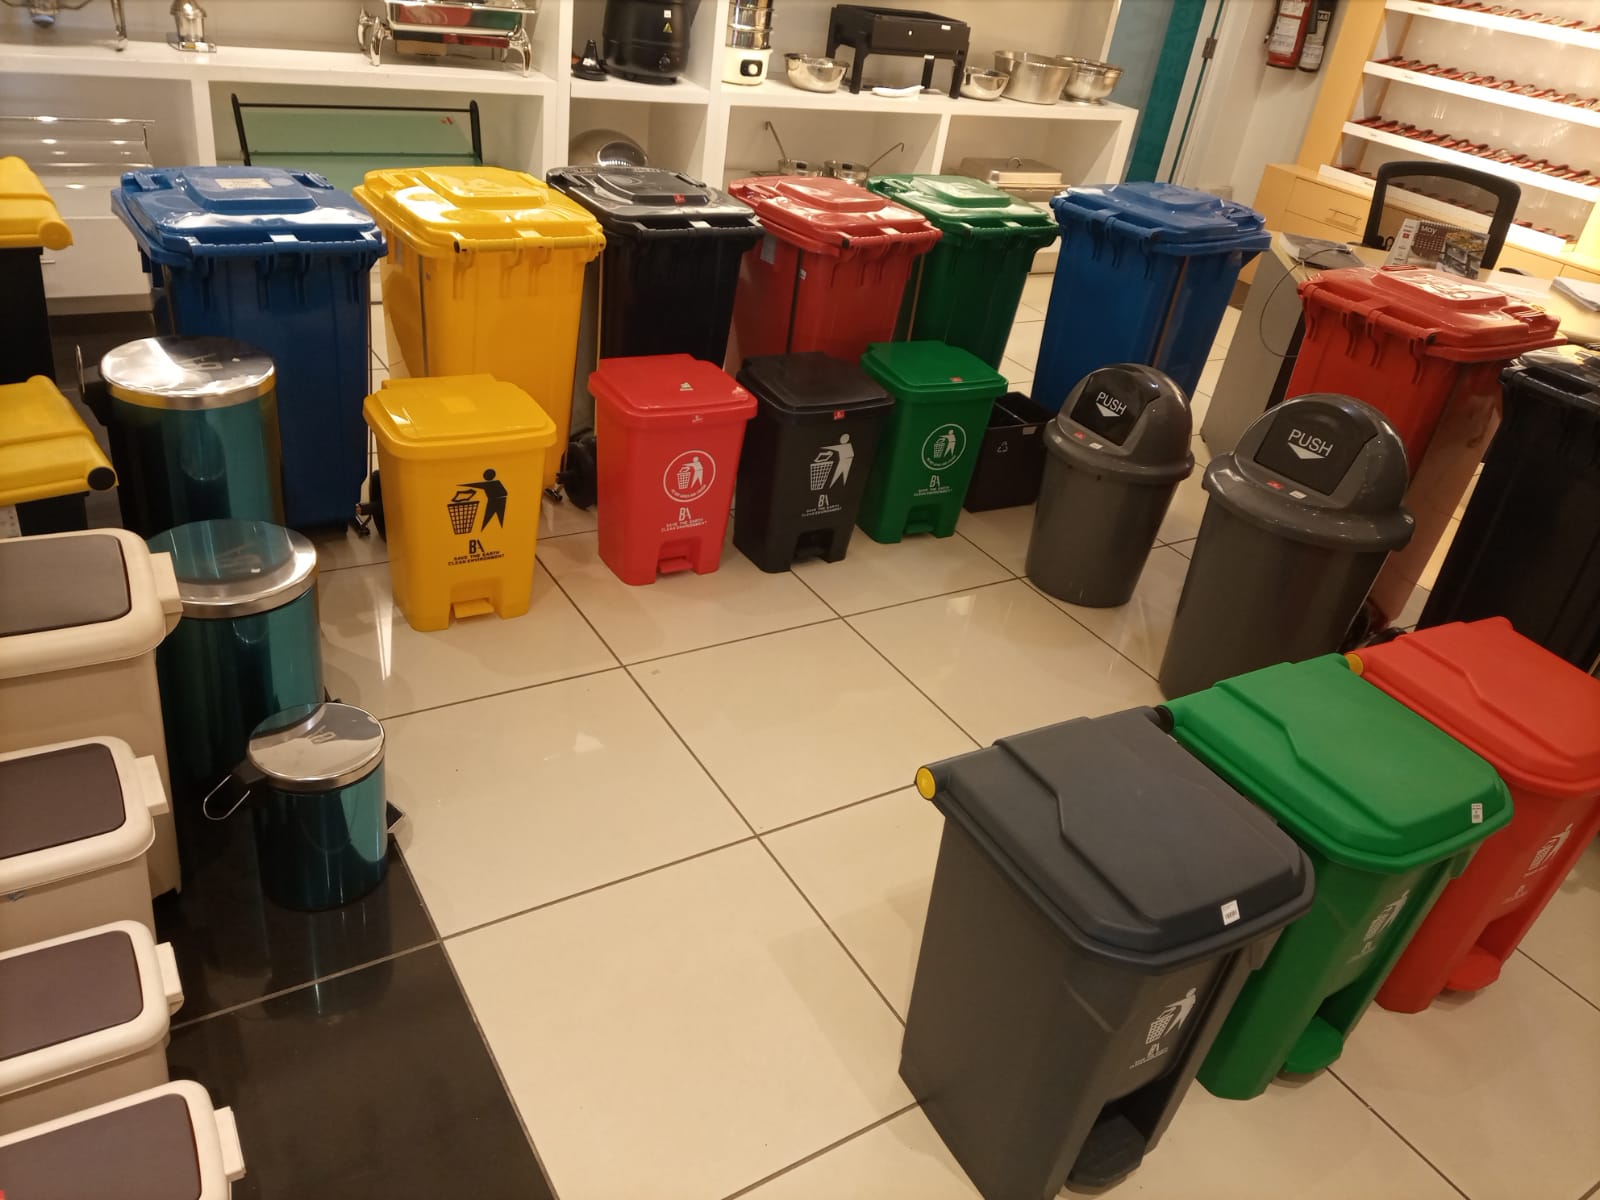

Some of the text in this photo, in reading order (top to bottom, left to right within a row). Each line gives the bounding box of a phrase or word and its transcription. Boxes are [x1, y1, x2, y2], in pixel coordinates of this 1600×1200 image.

[1421, 225, 1437, 235] May
[1096, 391, 1128, 416] PUSH
[1288, 428, 1334, 457] PUSH
